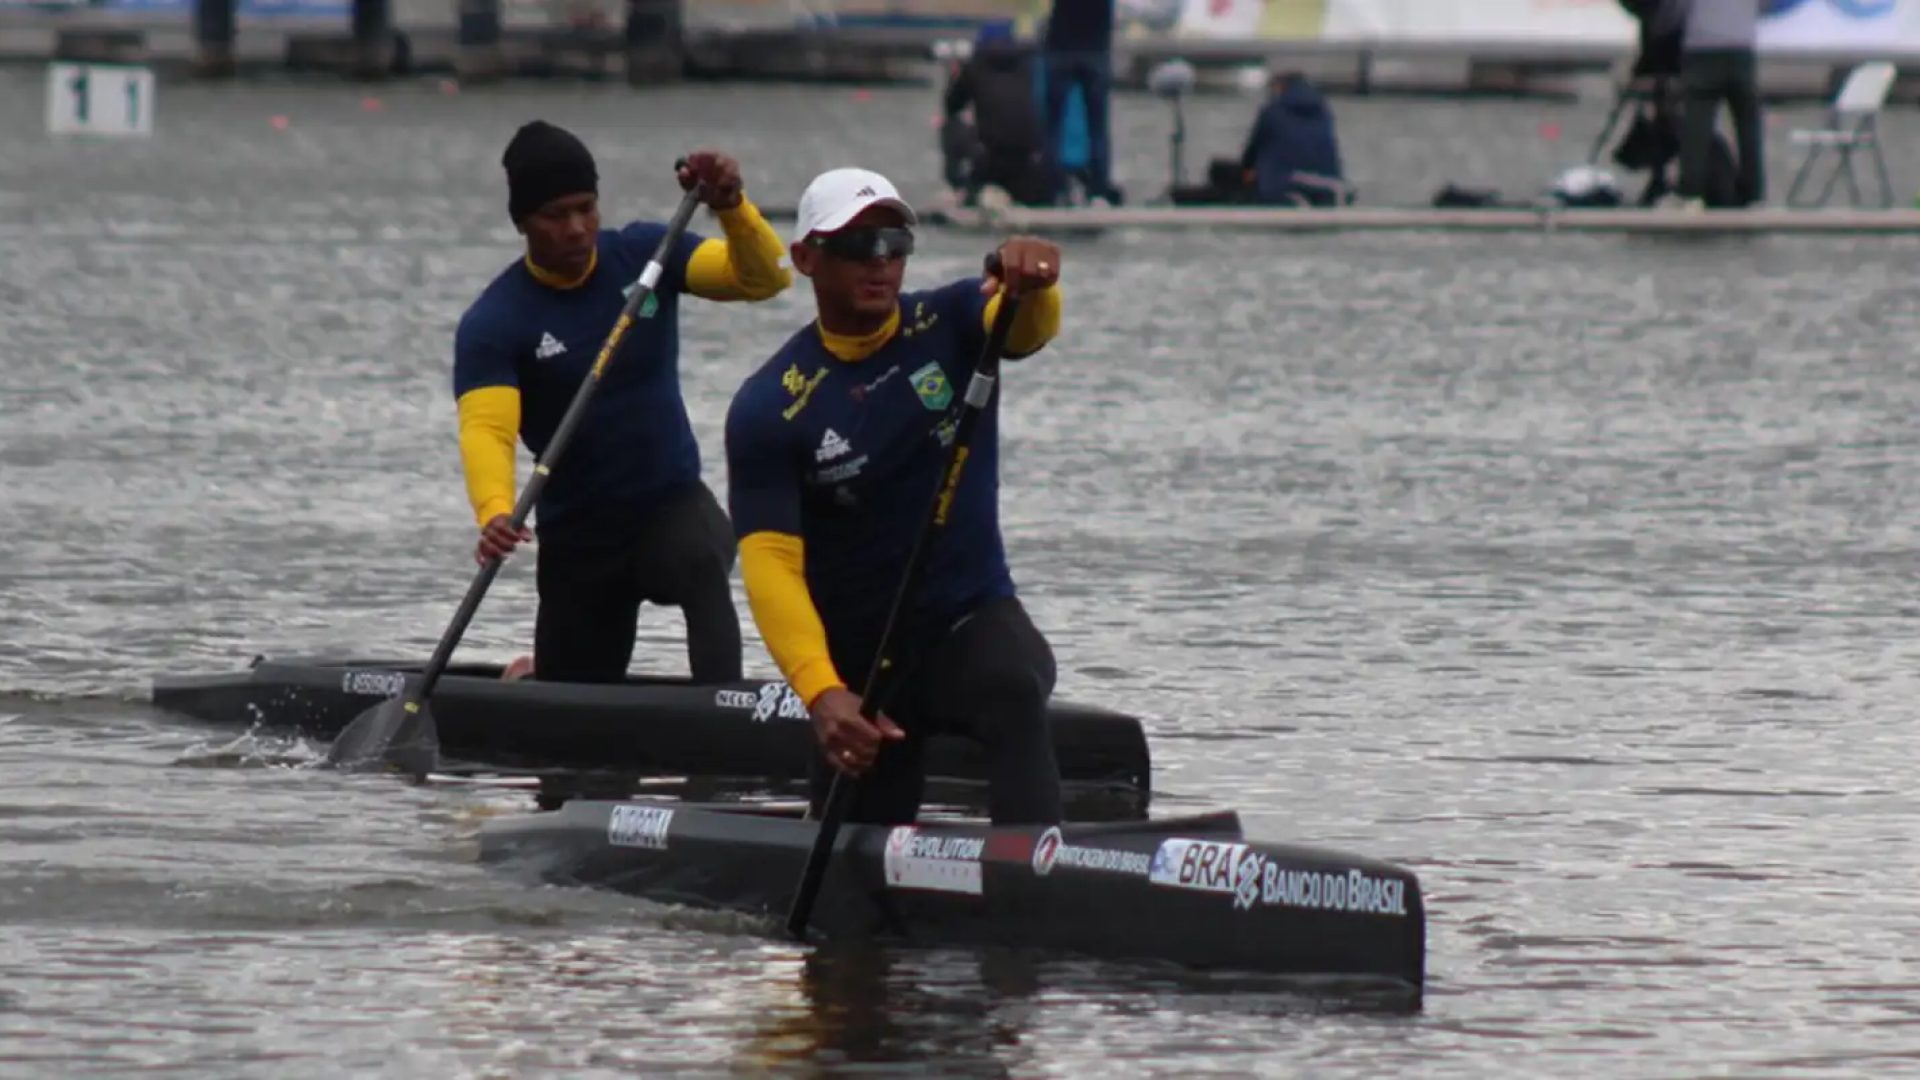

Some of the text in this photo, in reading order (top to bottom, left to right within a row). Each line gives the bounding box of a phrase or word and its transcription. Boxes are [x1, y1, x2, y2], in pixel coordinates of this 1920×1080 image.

[1179, 843, 1231, 889] BRA
[1262, 862, 1407, 915] BANCO DO BRASIL
